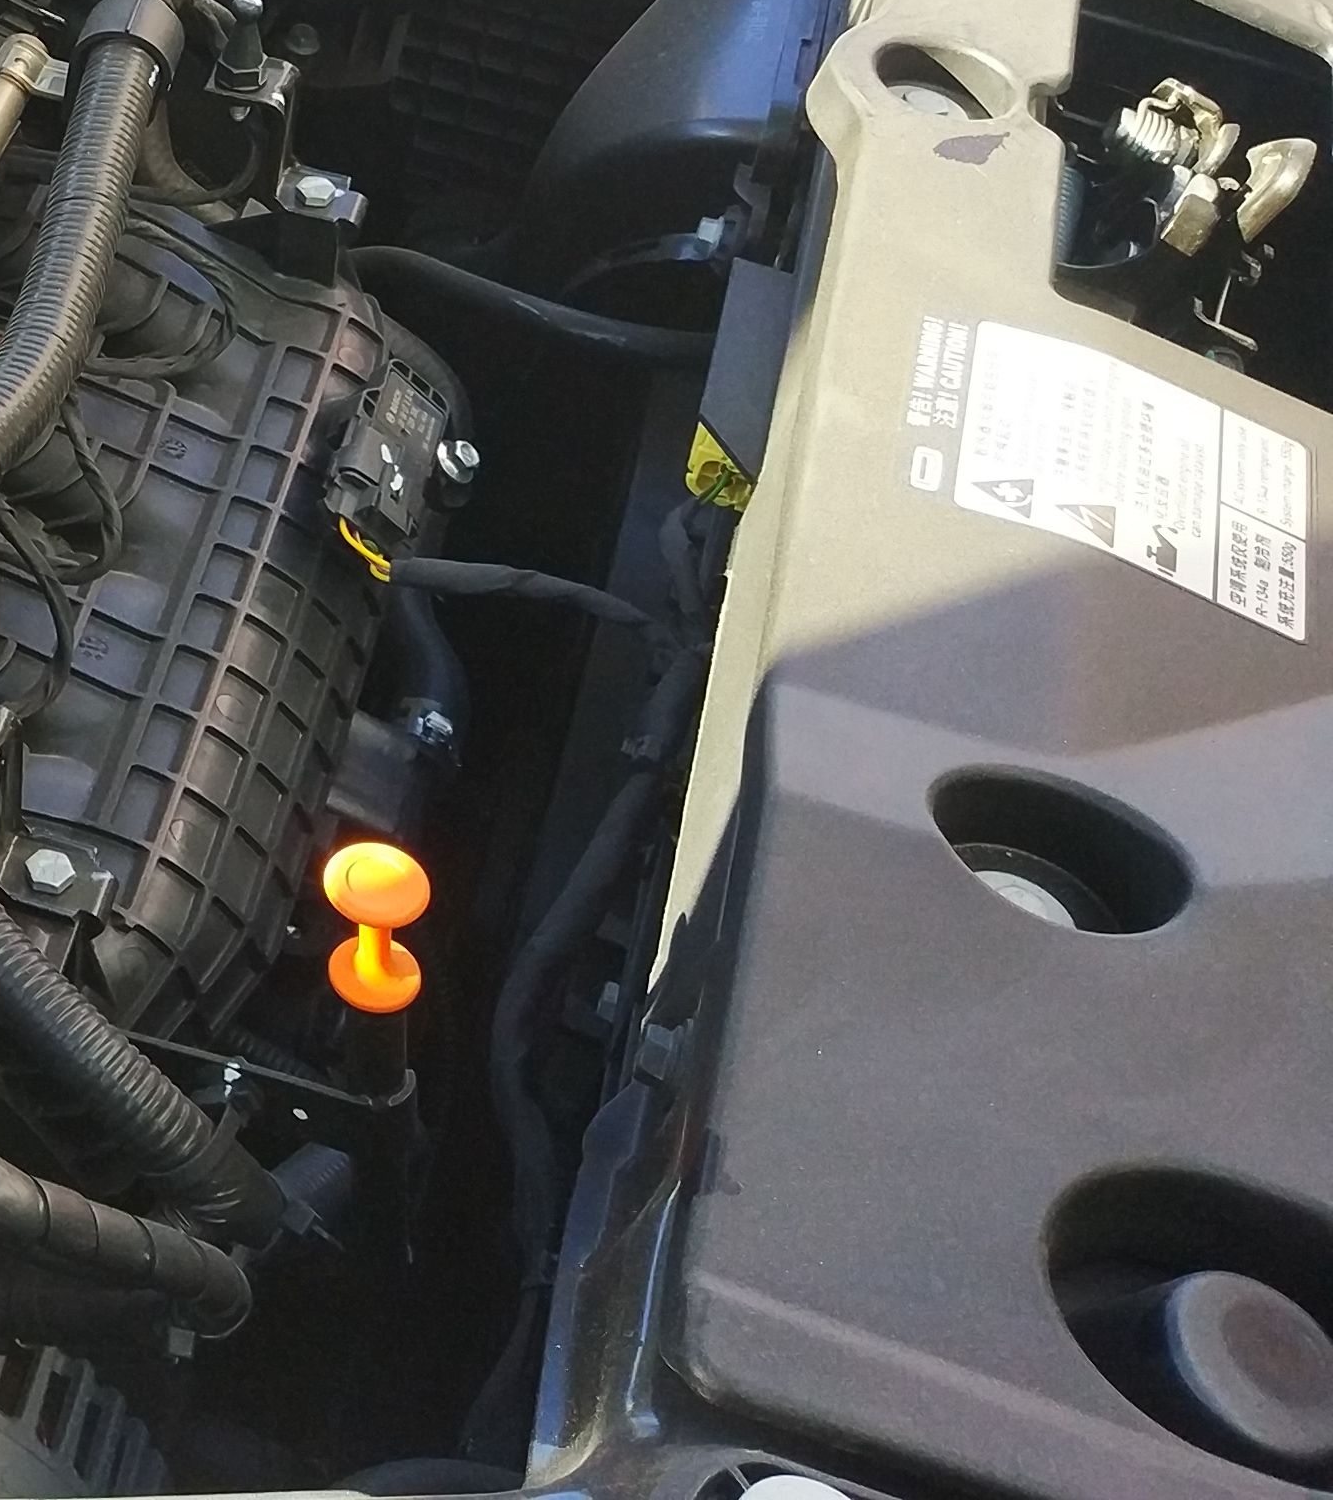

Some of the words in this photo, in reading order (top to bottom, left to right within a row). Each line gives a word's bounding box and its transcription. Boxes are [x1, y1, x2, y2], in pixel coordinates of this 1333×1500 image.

[913, 315, 944, 388] WARNING!
[939, 321, 969, 390] CAUTION!
[1191, 520, 1201, 537] can
[1230, 520, 1248, 607] 空调系统仅使用
[1256, 580, 1269, 618] R-134a
